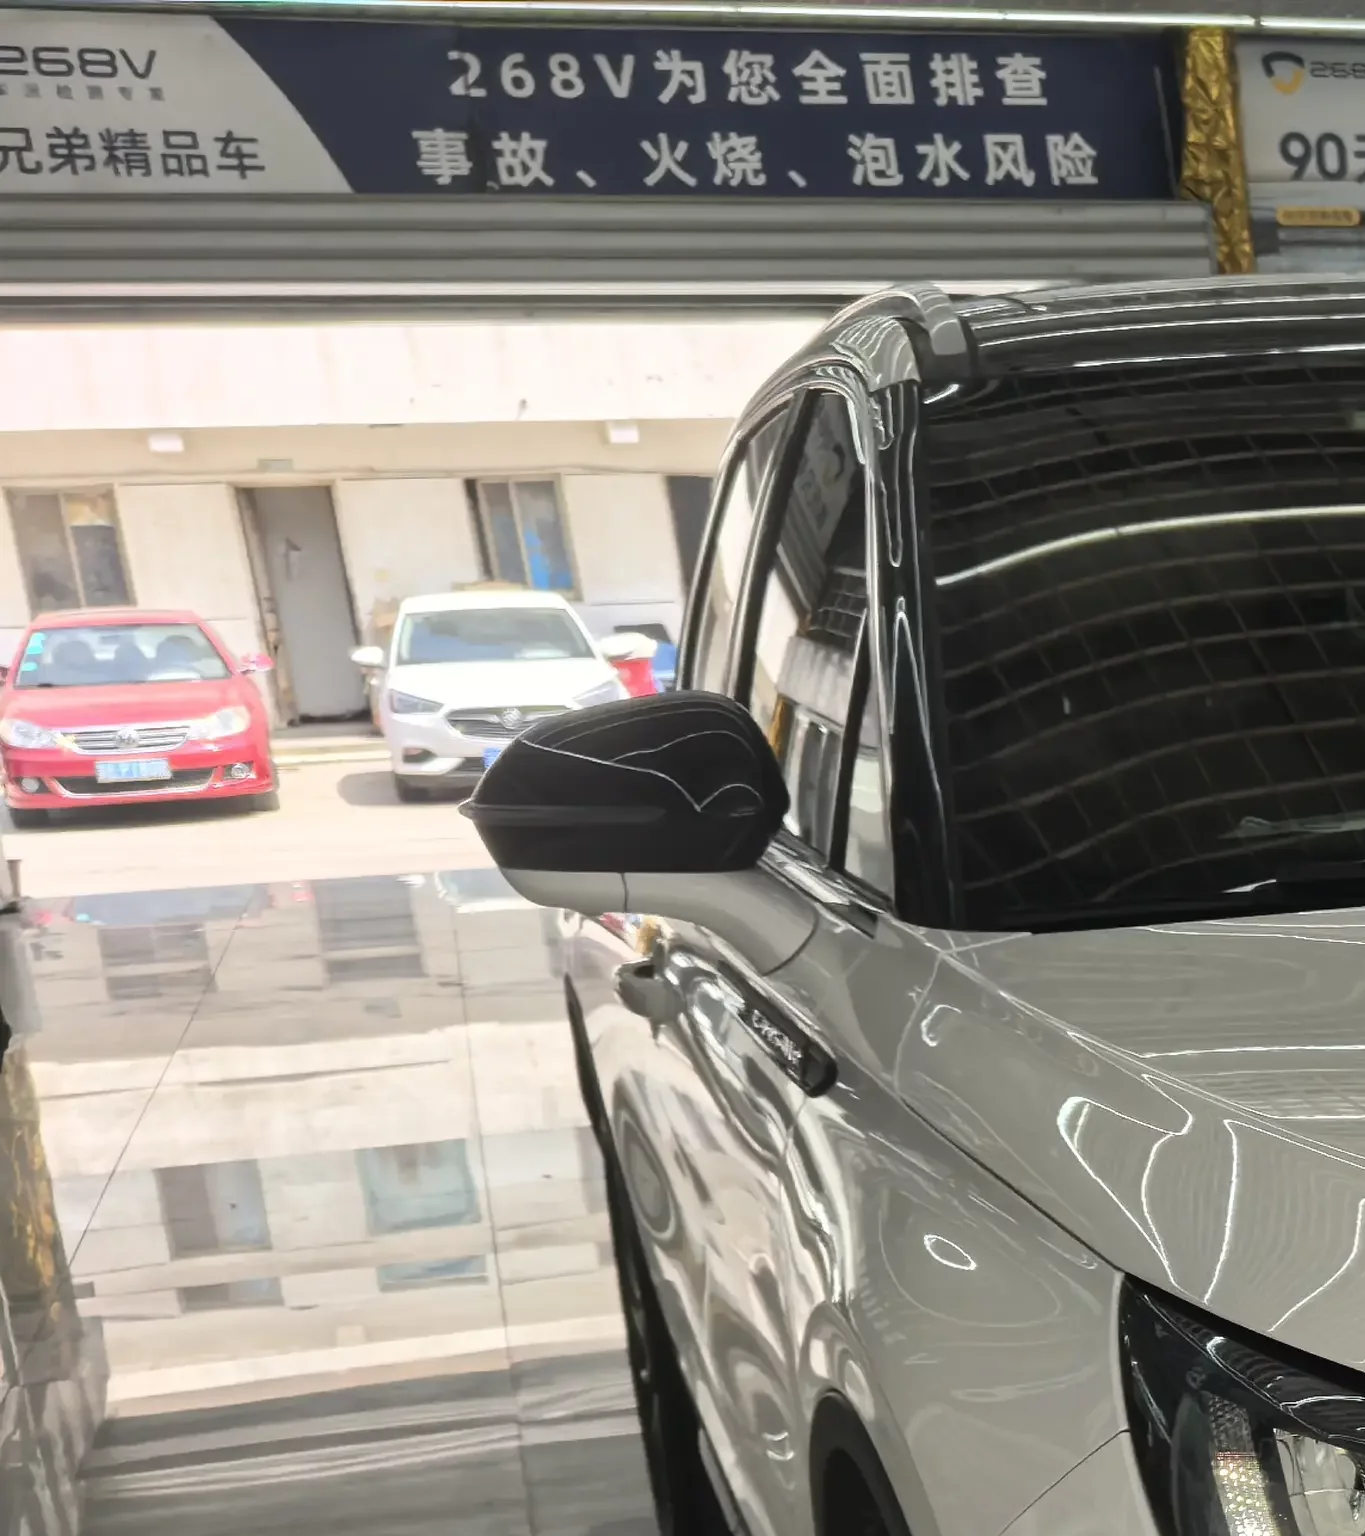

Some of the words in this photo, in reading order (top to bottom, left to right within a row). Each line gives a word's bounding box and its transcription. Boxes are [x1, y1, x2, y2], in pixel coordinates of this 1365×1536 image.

[0, 45, 157, 80] 268V
[446, 49, 1049, 107] 268V为您全面排查
[0, 125, 266, 180] 兄弟精品车
[411, 127, 1101, 189] 事故、火烧、泡水风险
